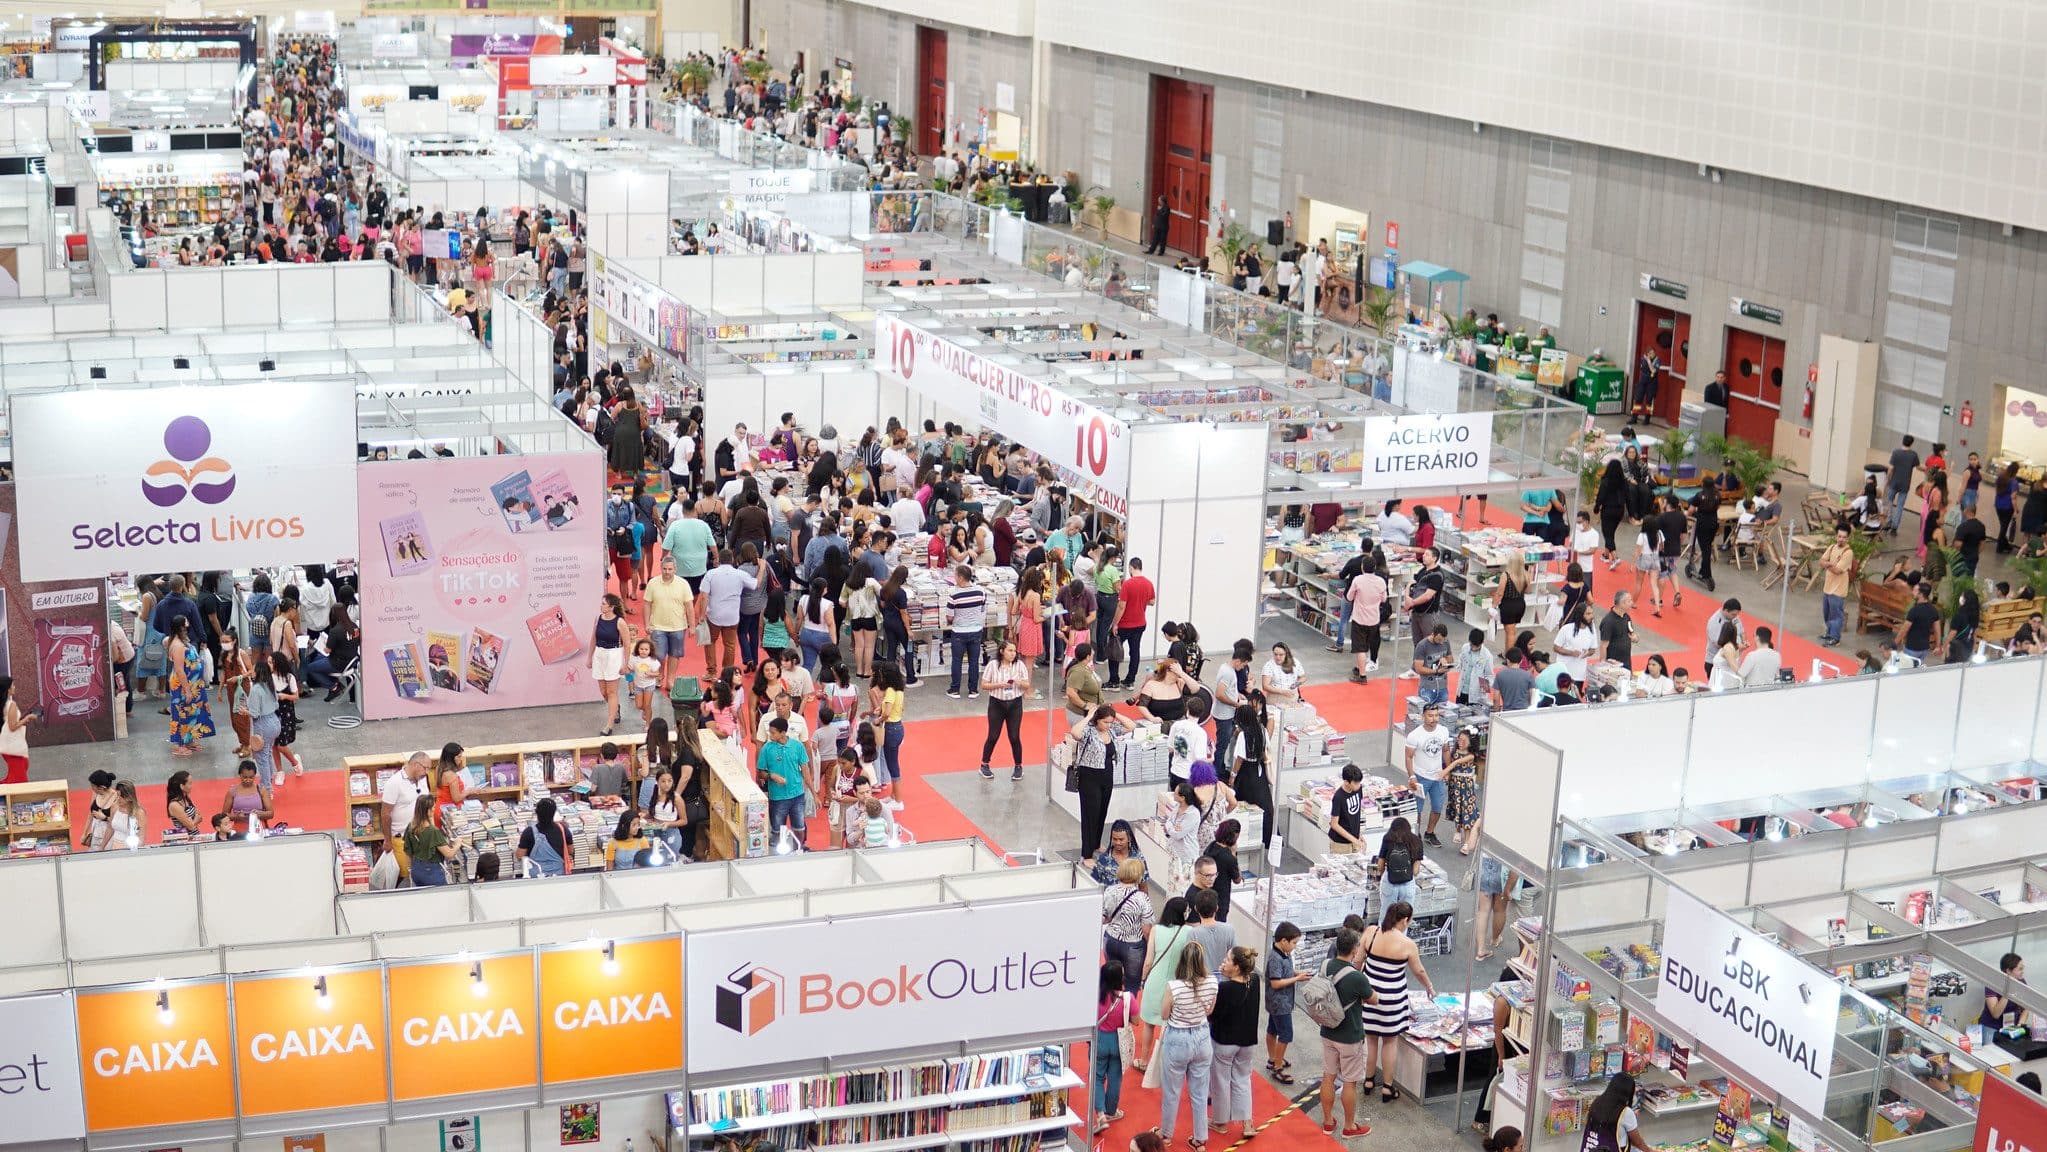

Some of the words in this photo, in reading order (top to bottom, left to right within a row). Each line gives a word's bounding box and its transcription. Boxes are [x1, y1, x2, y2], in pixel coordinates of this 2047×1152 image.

[890, 321, 915, 379] 10
[932, 339, 1004, 396] QUALQUER
[1075, 415, 1108, 477] 10
[1388, 426, 1470, 447] ACERVO
[1375, 449, 1479, 474] LITERÁRIO
[1097, 487, 1127, 515] CAIXA
[72, 519, 201, 550] Selecta
[211, 515, 305, 542] Livros
[441, 552, 501, 570] Sensações
[503, 553, 517, 564] do
[36, 595, 51, 607] EM
[53, 591, 94, 605] OUTUBRO
[799, 949, 1076, 1015] BookOutlet
[403, 1008, 524, 1047] CAIXA
[554, 991, 671, 1030] CAIXA
[1665, 957, 1824, 1080] EDUCACIONAL
[94, 1037, 218, 1077] CAIXA
[250, 1023, 374, 1063] CAIXA
